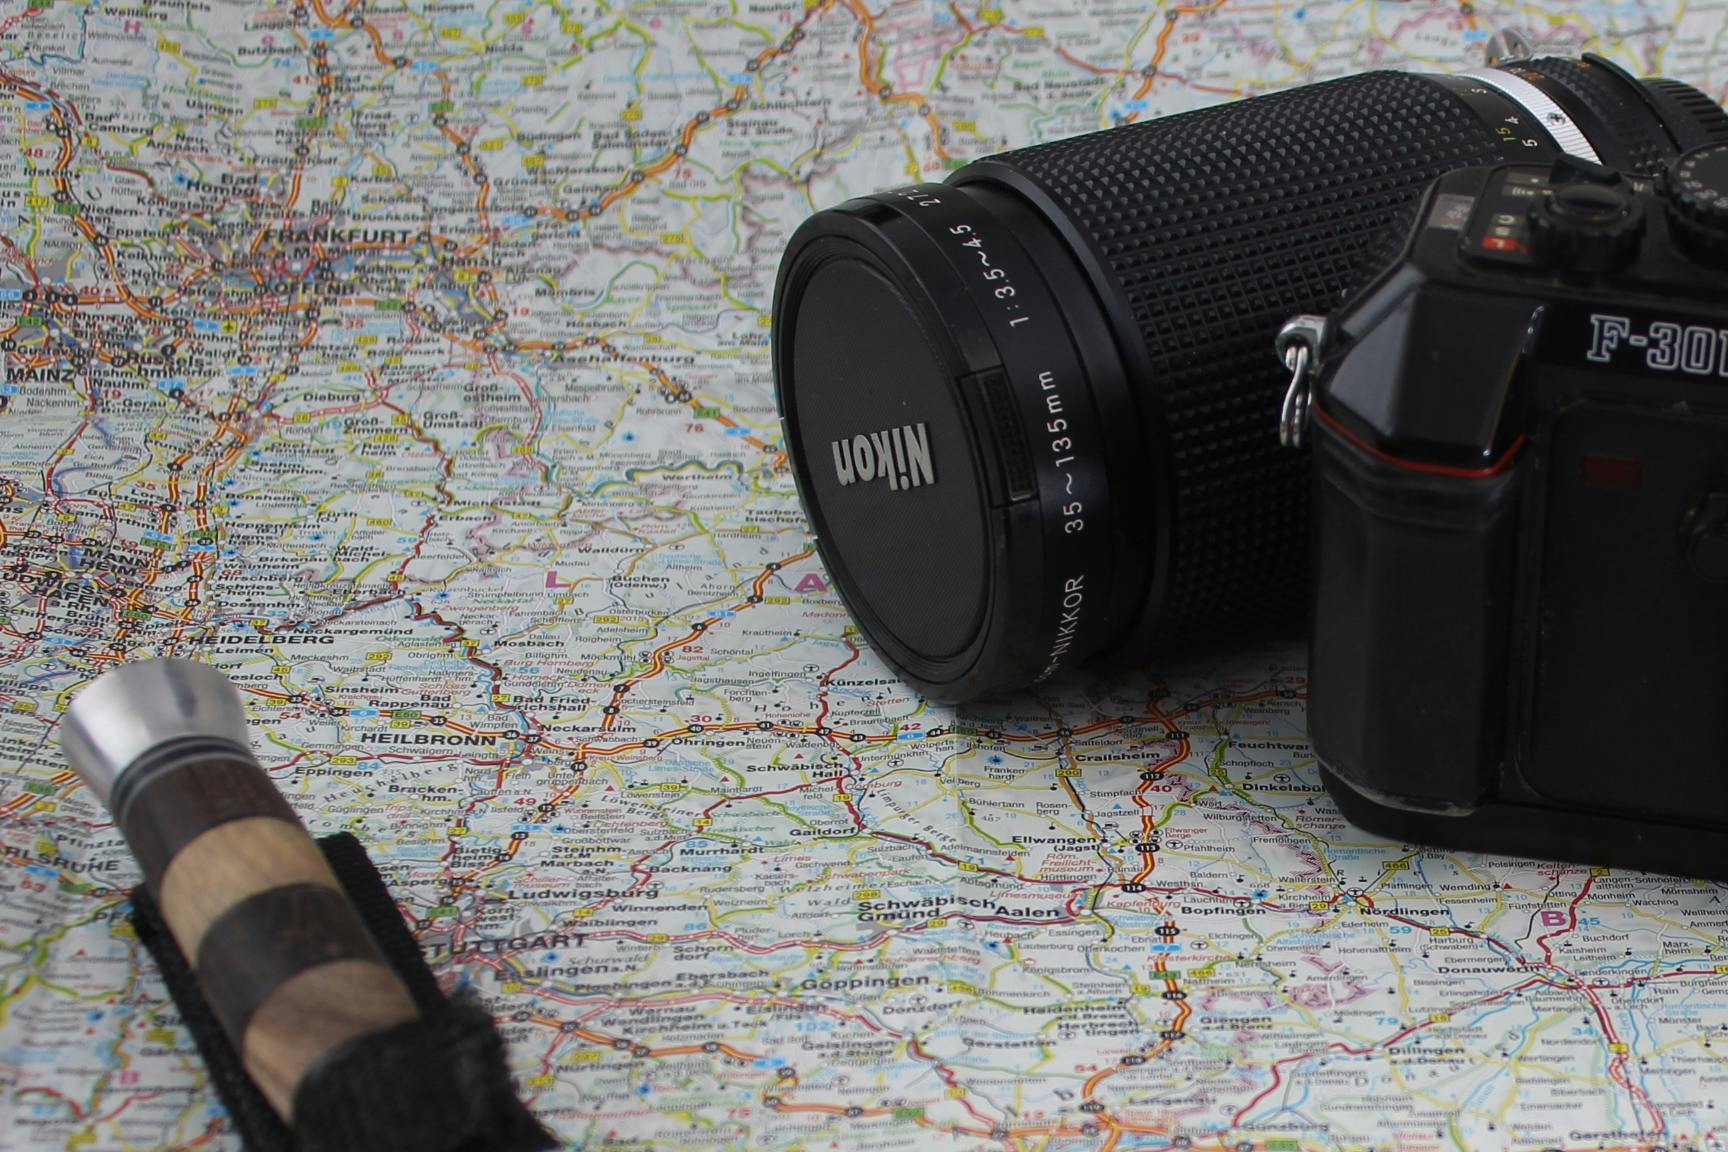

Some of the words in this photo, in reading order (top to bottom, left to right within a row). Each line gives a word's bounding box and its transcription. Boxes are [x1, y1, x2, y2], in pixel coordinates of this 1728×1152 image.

[7, 368, 75, 383] MAINZ
[832, 423, 935, 491] Nikon
[189, 635, 333, 645] HEIDELBERG
[361, 734, 496, 746] HEILBRONN
[672, 737, 745, 748] Öhringen
[1075, 752, 1161, 762] Crailsheim
[295, 768, 372, 778] Eppingen
[812, 769, 843, 778] Hall
[789, 827, 855, 837] Gaildorf
[1012, 836, 1096, 846] Ellwangen
[995, 906, 1059, 918] Aalen
[1181, 907, 1266, 916] Bopfingen
[1360, 907, 1449, 916] Nördlingen
[418, 932, 590, 957] TUTTGART
